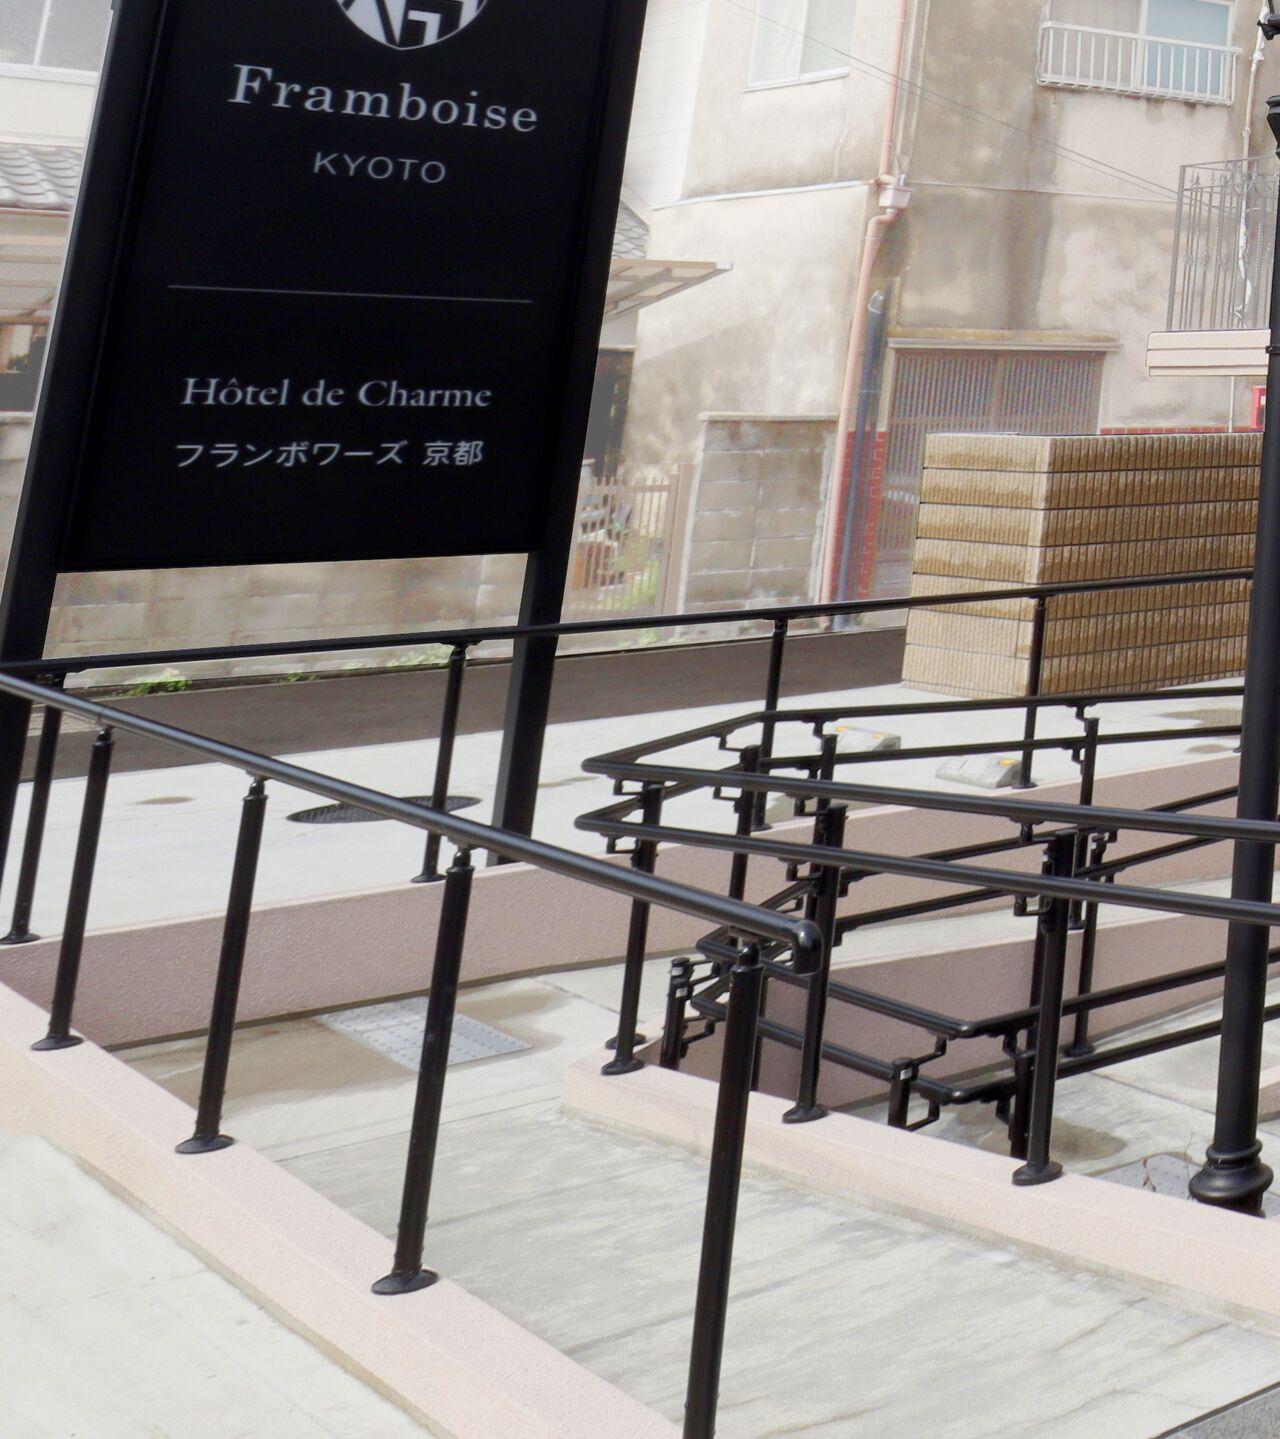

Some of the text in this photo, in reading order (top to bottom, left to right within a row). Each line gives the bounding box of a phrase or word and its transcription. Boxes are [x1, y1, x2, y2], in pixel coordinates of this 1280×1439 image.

[229, 63, 537, 132] Framboise
[313, 151, 447, 184] KYOTO
[182, 377, 492, 408] Hôtel de Charme
[175, 440, 485, 468] フランボワーズ 京都
